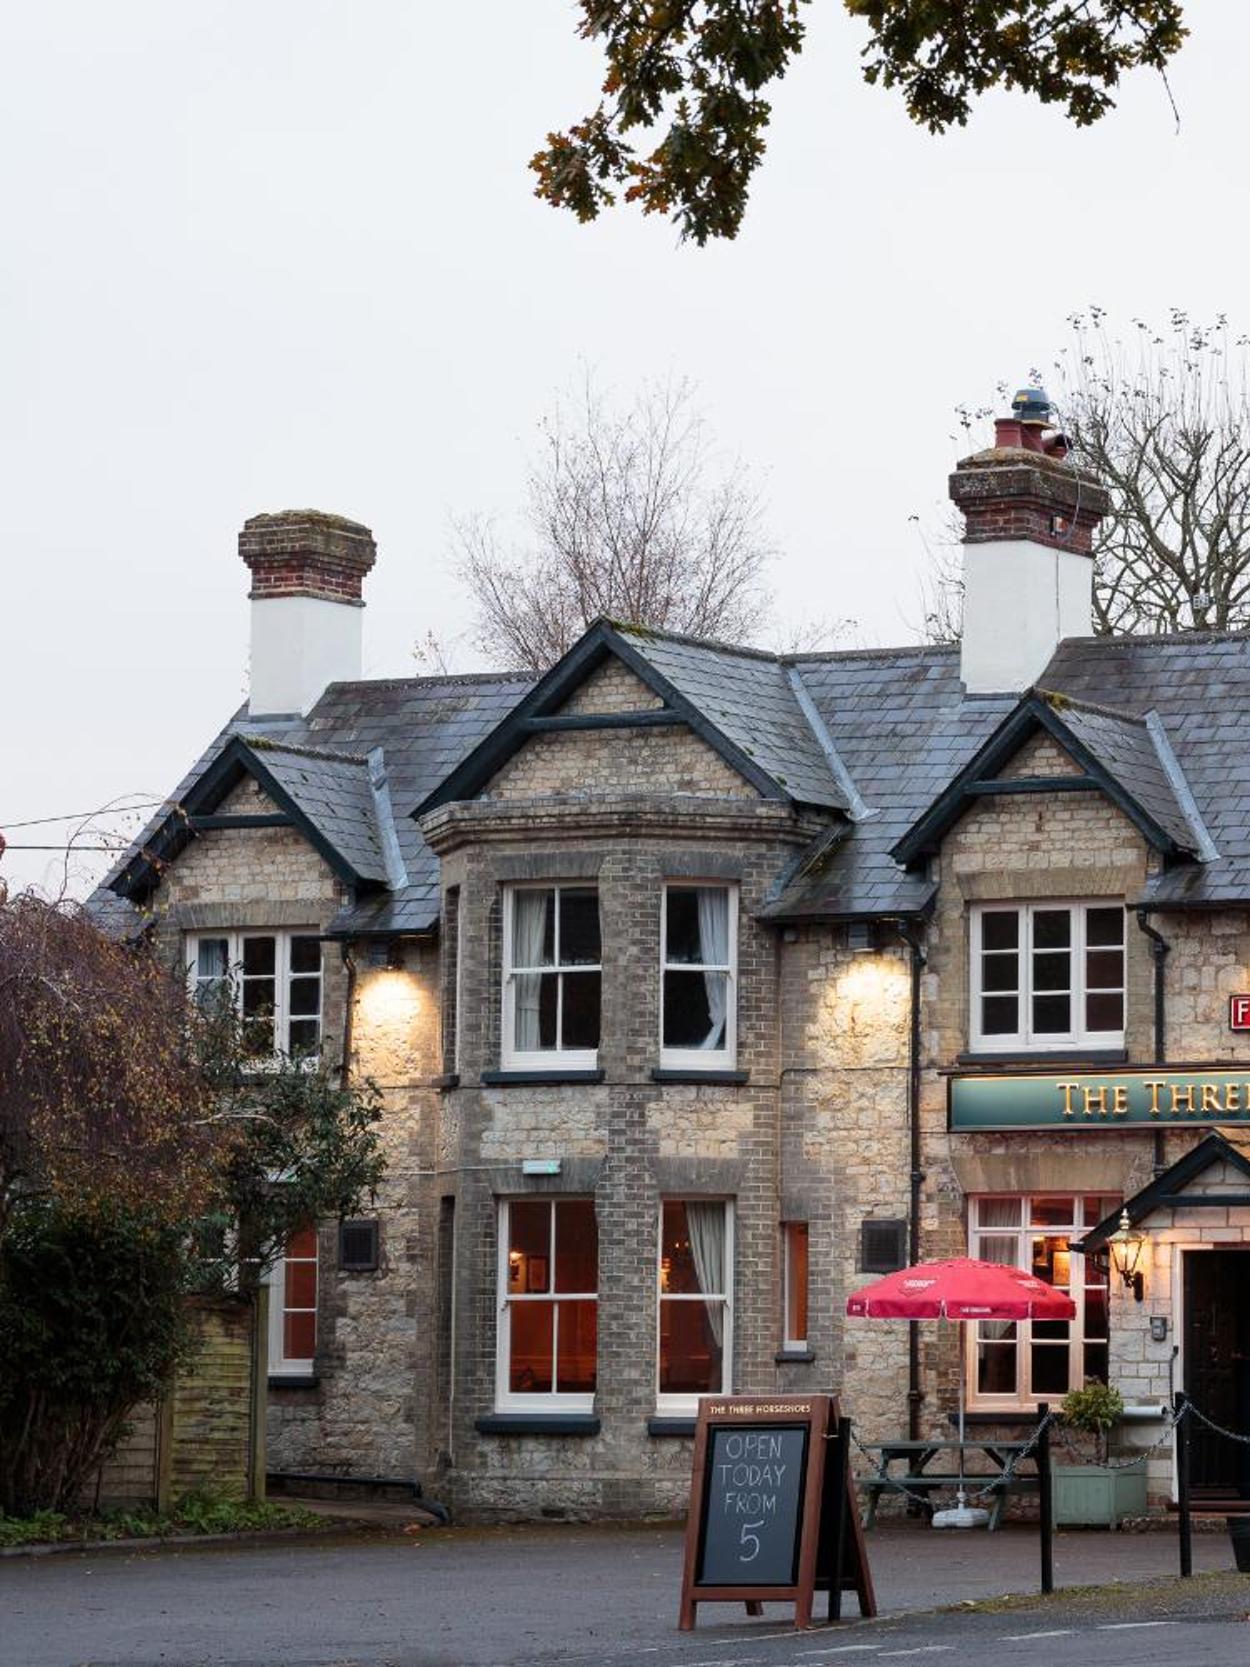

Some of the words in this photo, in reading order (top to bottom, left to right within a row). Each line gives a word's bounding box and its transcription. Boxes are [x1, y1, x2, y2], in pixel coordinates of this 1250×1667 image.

[1056, 1082, 1128, 1115] THE
[709, 1406, 726, 1415] THE
[729, 1405, 754, 1414] THREE
[726, 1434, 783, 1459] OPEN
[718, 1463, 786, 1487] TODAY
[724, 1492, 776, 1516] FROM
[739, 1519, 765, 1562] 5
